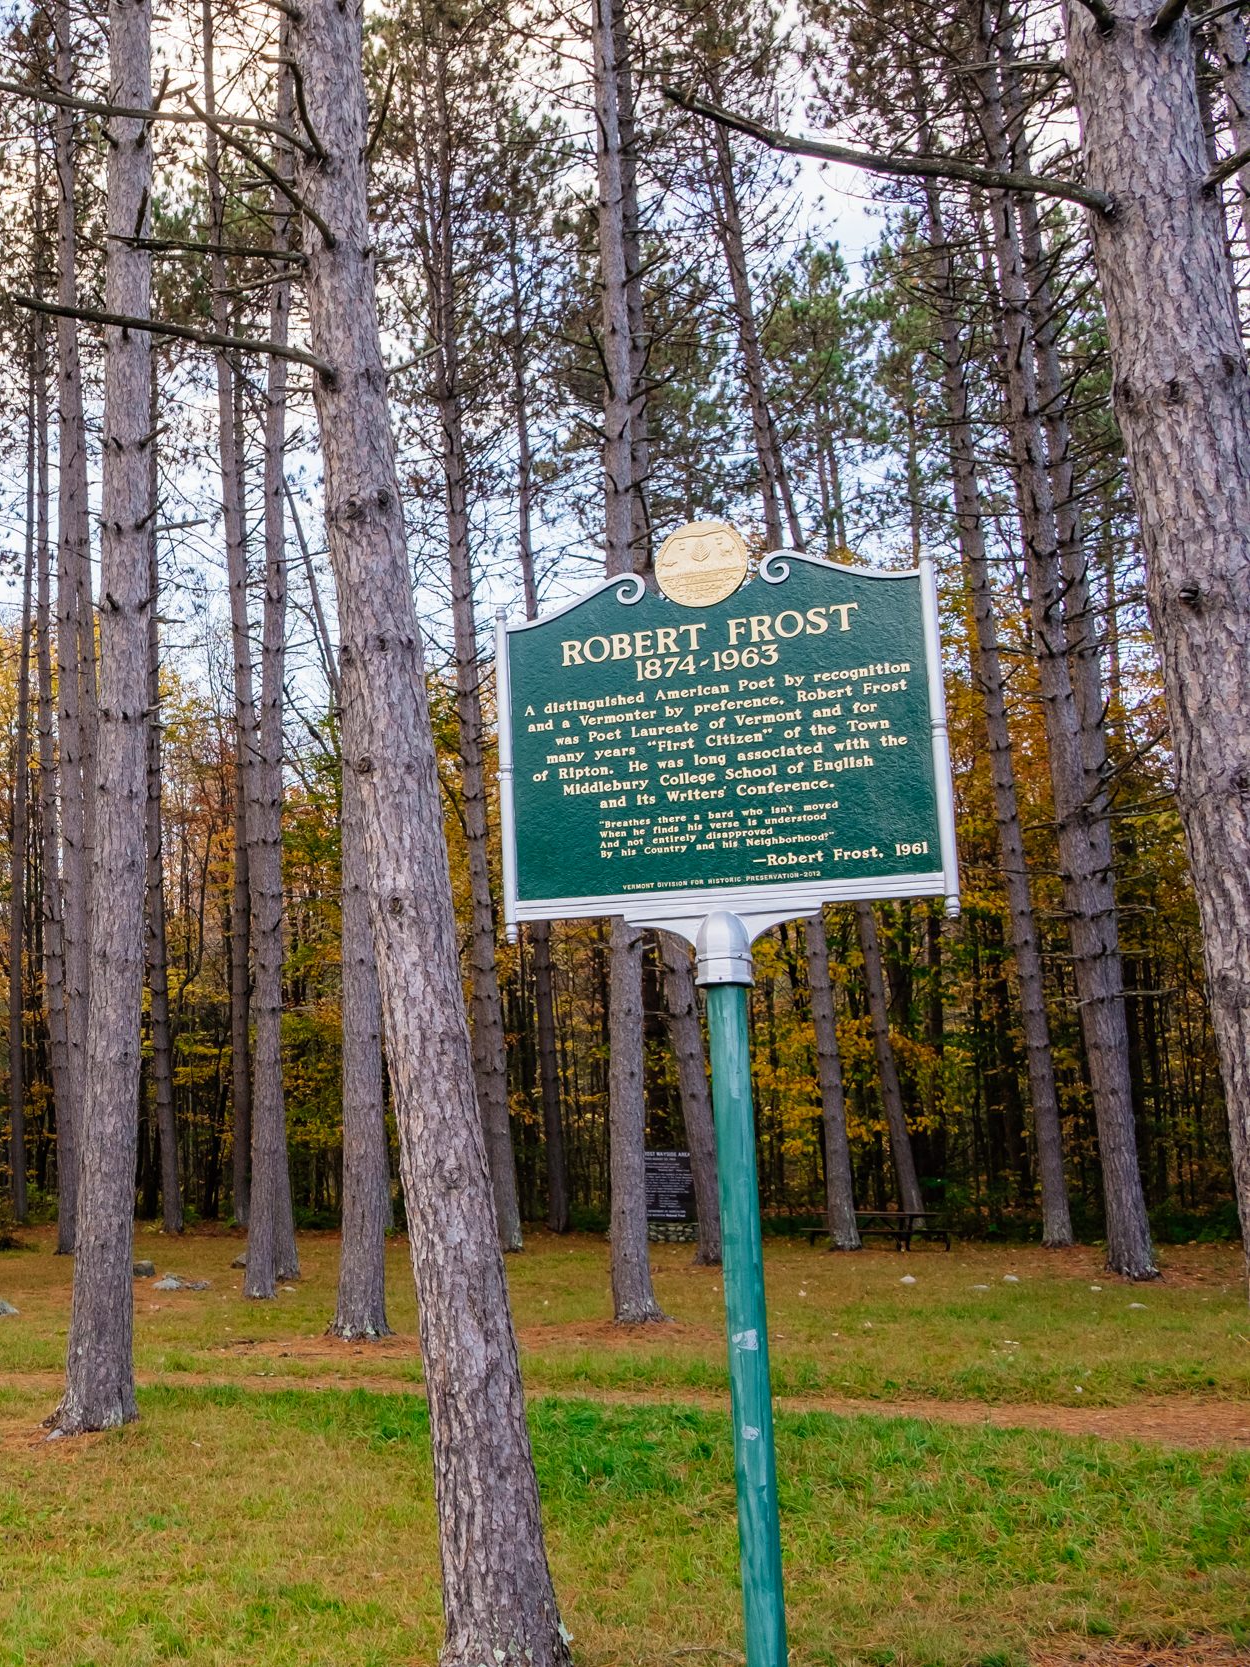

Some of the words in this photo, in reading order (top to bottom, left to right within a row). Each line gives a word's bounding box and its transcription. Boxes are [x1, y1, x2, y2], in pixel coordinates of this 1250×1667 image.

[560, 622, 707, 666] ROBERT
[726, 602, 859, 646] FROST
[635, 644, 779, 682] 1874-1963
[524, 705, 536, 716] A
[544, 691, 645, 714] distinguished
[654, 684, 730, 701] American
[738, 676, 775, 692] Poet
[783, 674, 806, 687] by
[813, 661, 911, 682] recognition
[528, 719, 554, 732] and
[562, 720, 571, 728] a
[578, 709, 657, 726] Vermonter
[664, 706, 684, 718] by
[796, 684, 853, 702] Robert
[862, 678, 908, 695] Frost
[546, 752, 585, 764] many
[594, 746, 636, 760] years
[784, 726, 802, 739] of
[809, 724, 837, 736] the
[846, 720, 890, 732] Town
[555, 736, 579, 746] was
[588, 728, 622, 742] Poet
[631, 720, 699, 738] Laureate
[708, 716, 726, 729] of
[734, 708, 802, 726] Vermont
[812, 704, 842, 718] and
[852, 702, 878, 714] for
[532, 770, 549, 782] of
[558, 766, 614, 780] Ripton.
[628, 760, 648, 772] He
[656, 758, 684, 769] was
[694, 754, 726, 766] long
[737, 741, 824, 762] associated
[833, 737, 870, 752] with
[879, 734, 908, 747] the
[563, 779, 649, 796] Middlebury
[660, 772, 716, 786] College
[725, 764, 777, 780] School
[787, 761, 805, 774] of
[813, 755, 874, 772] English
[600, 795, 627, 809] and
[636, 794, 656, 806] its
[736, 780, 835, 796] Conference.
[657, 815, 686, 824] there
[708, 810, 734, 819] bard
[741, 808, 763, 816] who
[771, 804, 793, 814] isn't
[803, 800, 838, 812] moved
[599, 830, 627, 838] When
[633, 828, 646, 836] he
[652, 825, 679, 834] finds
[687, 823, 703, 831] his
[710, 821, 740, 829] verse
[748, 818, 757, 826] is
[764, 812, 827, 824] understood
[600, 840, 620, 848] And
[627, 838, 644, 846] not
[652, 834, 696, 844] entirely
[706, 827, 773, 840] disapproved
[600, 850, 613, 859] By
[621, 848, 636, 856] his
[644, 845, 688, 854] Country
[696, 842, 715, 850] and
[722, 840, 738, 848] his
[895, 841, 928, 856] 1961
[622, 882, 654, 890] VERMONT
[657, 880, 688, 888] DIVISION
[708, 876, 741, 884] HISTORIC
[746, 870, 821, 882] PRESERVATION-2012
